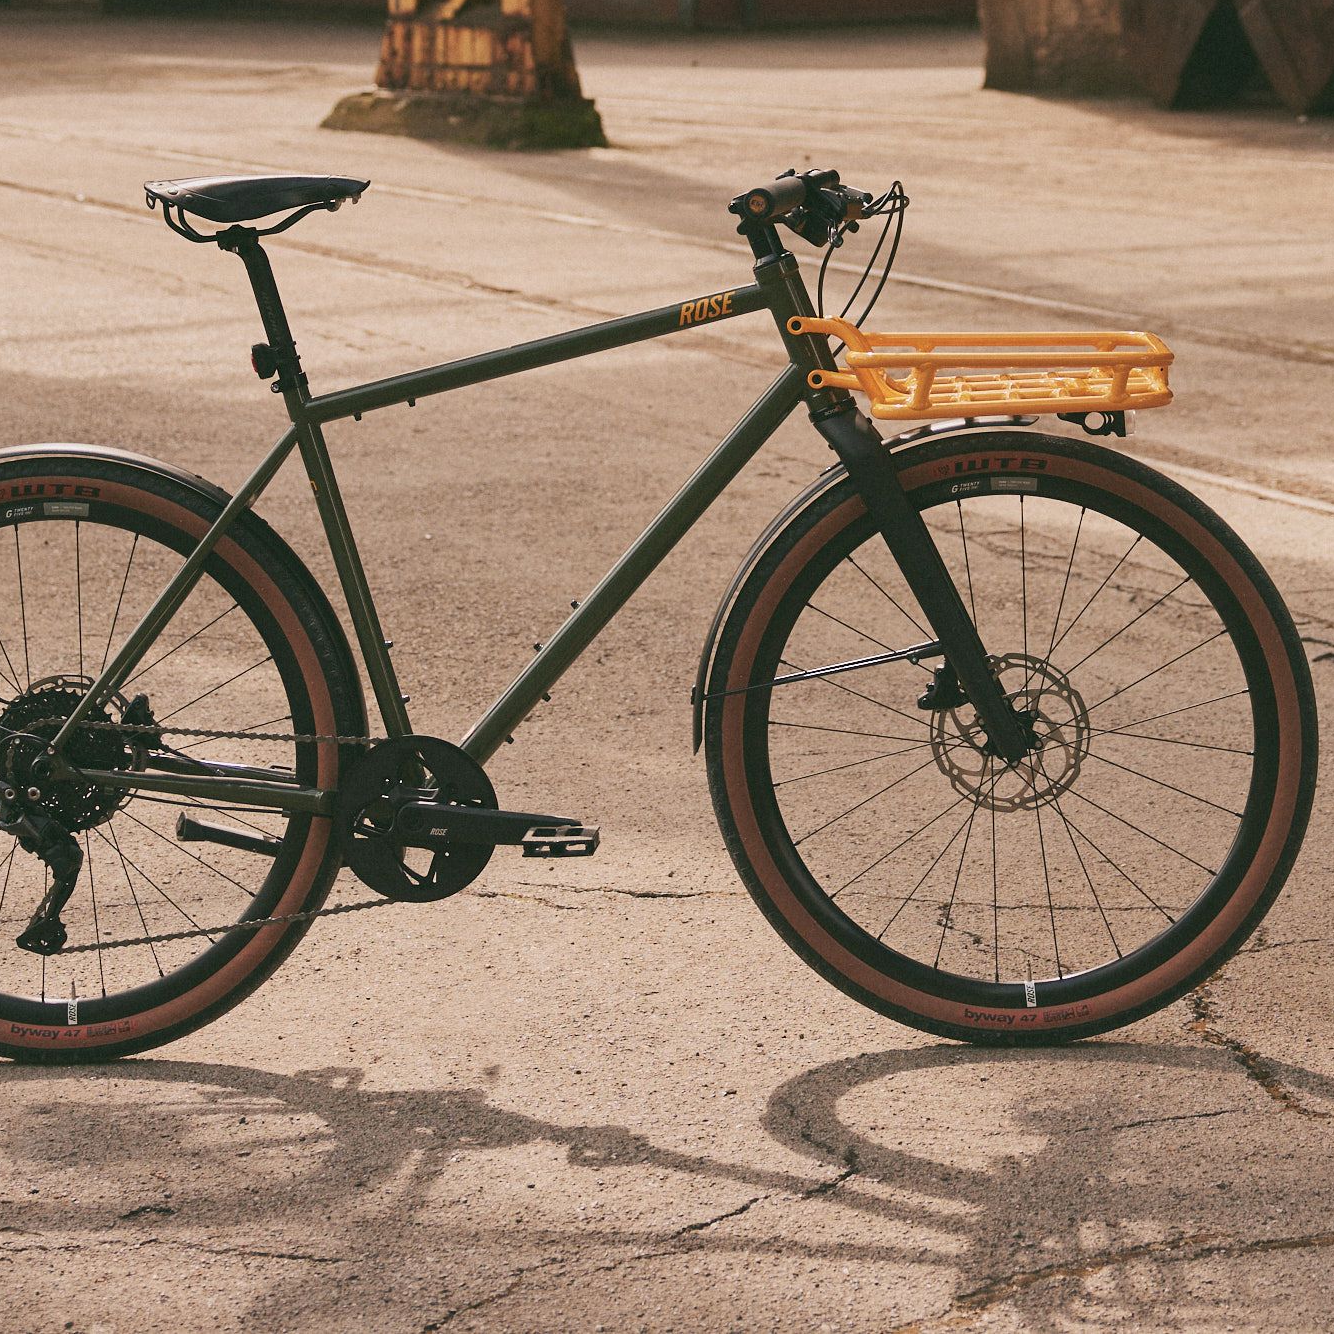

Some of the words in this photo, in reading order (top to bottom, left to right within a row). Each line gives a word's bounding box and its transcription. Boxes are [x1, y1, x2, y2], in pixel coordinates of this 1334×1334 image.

[679, 291, 736, 326] ROSE
[955, 458, 1047, 473] WTB
[11, 484, 100, 497] WTB
[951, 484, 959, 493] G
[5, 509, 13, 518] G
[429, 827, 448, 836] ROSE
[1026, 985, 1036, 1004] ROSE
[68, 1003, 77, 1022] ROSE
[964, 1008, 1016, 1025] byway
[1019, 1014, 1037, 1022] 47
[10, 1024, 60, 1040] byway
[63, 1029, 81, 1037] 47
